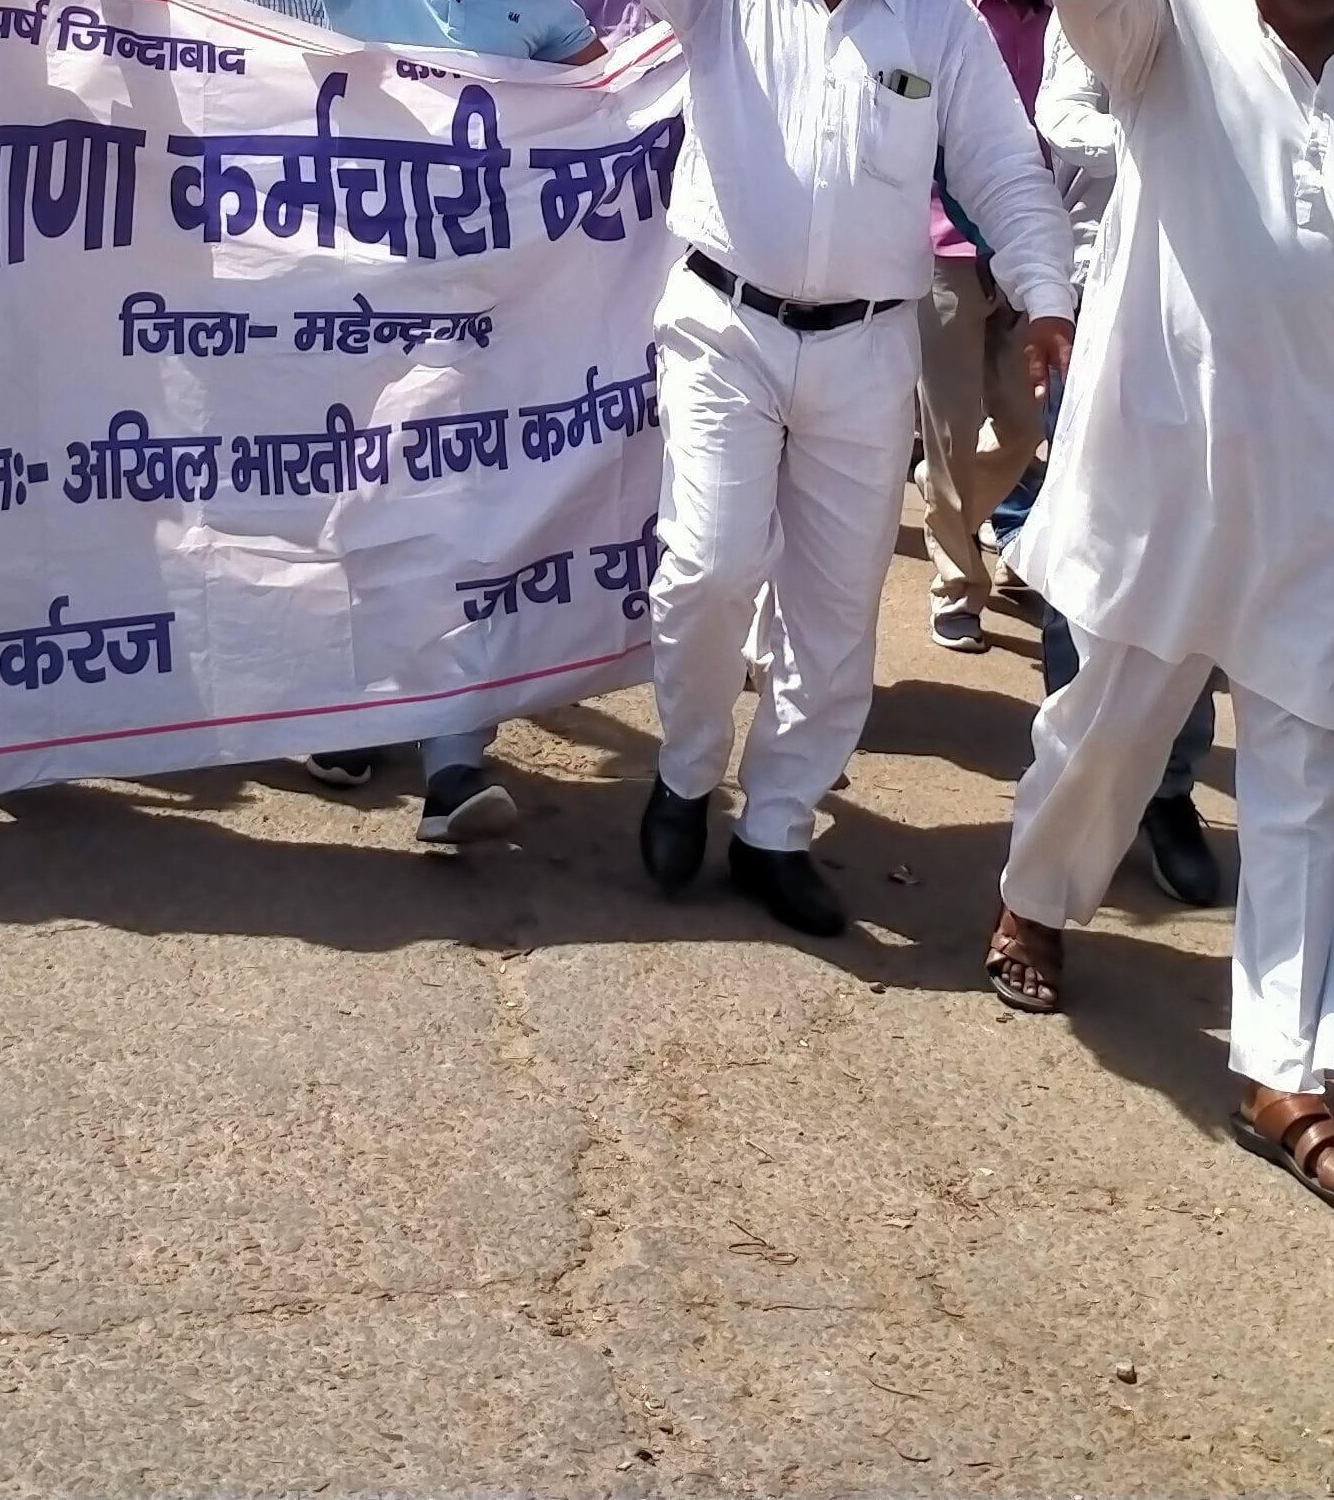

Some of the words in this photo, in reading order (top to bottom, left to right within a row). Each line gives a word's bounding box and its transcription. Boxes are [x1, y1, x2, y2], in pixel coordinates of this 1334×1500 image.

[56, 3, 247, 78] जिन्दाबाद
[166, 71, 512, 261] कर्मचारी
[62, 407, 224, 506] अखिल
[231, 402, 393, 498] भारतीय
[402, 408, 509, 481] राज्य
[456, 549, 574, 622] जय
